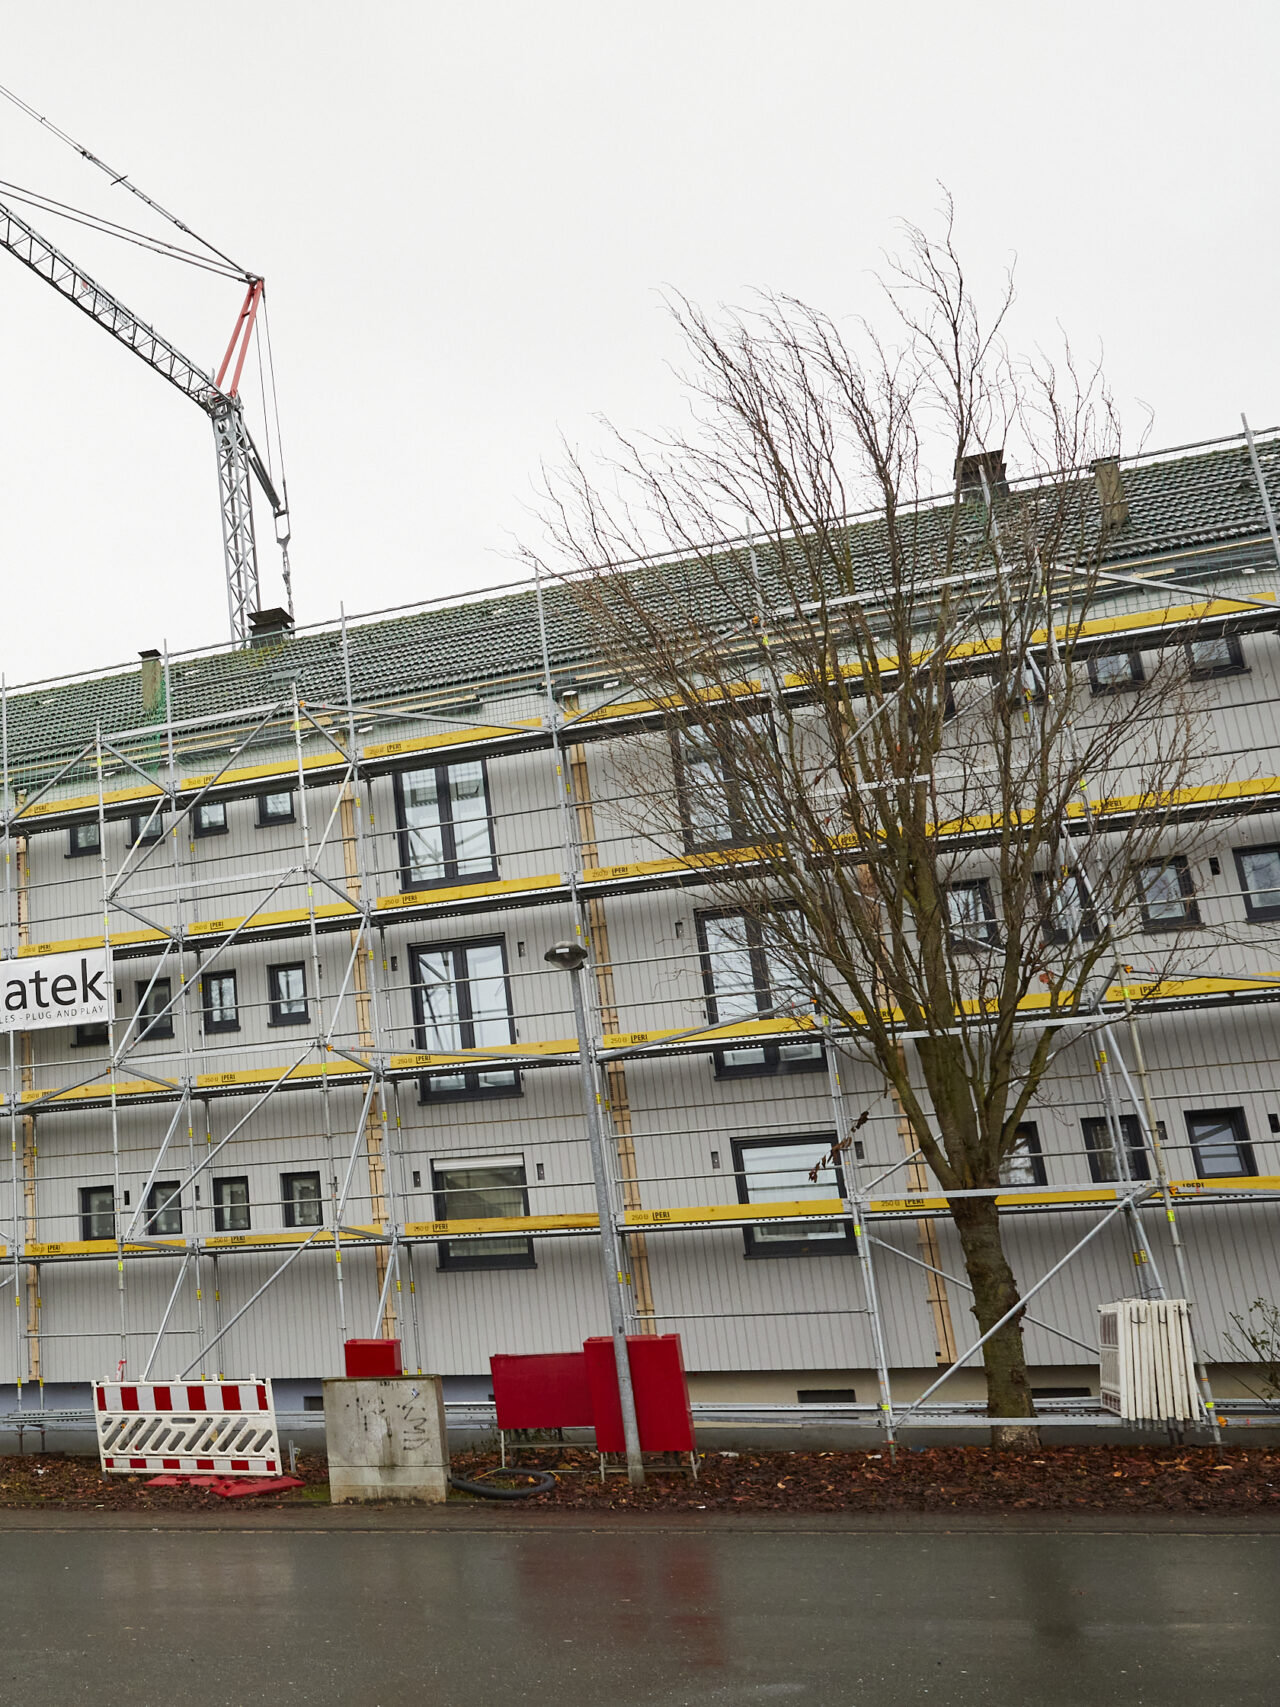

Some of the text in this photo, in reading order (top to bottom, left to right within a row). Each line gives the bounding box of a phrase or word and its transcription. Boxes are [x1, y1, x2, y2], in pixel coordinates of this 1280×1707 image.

[26, 1011, 52, 1021] PLUG
[57, 1009, 77, 1018] AND
[81, 1005, 104, 1015] PLAY
